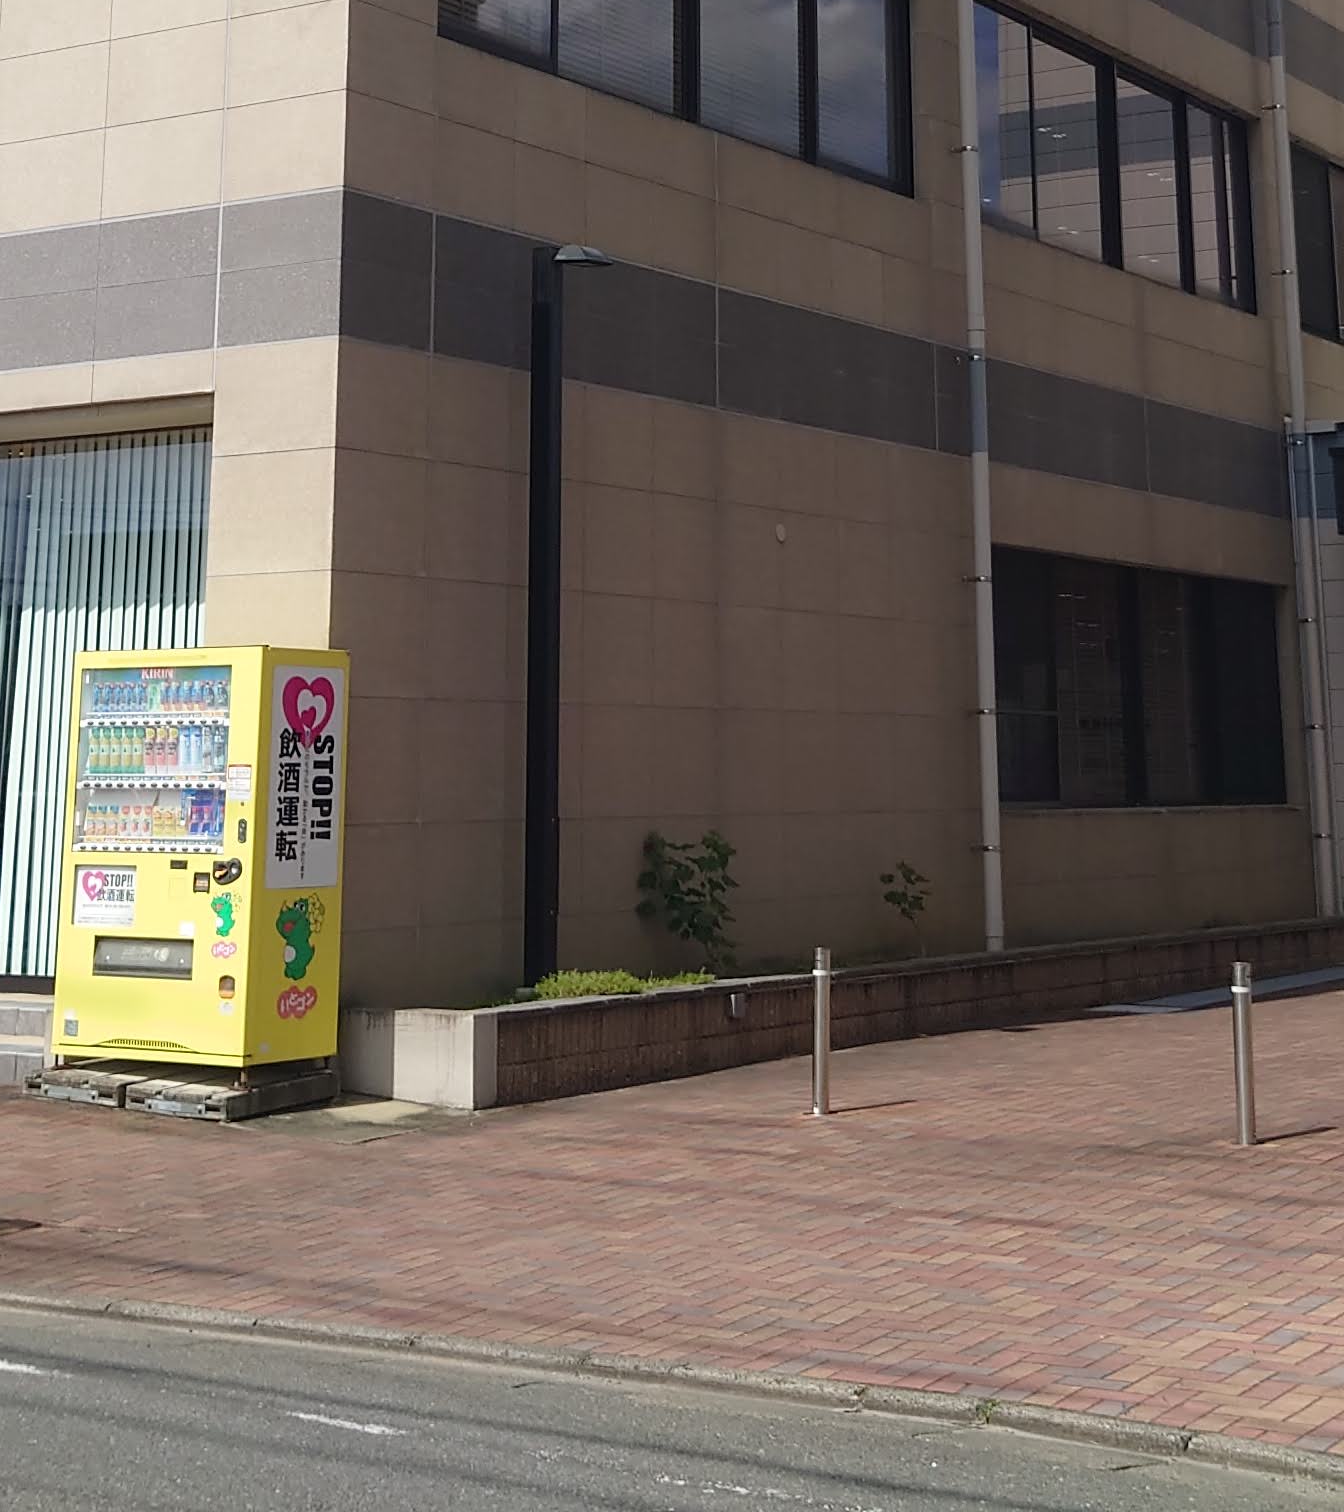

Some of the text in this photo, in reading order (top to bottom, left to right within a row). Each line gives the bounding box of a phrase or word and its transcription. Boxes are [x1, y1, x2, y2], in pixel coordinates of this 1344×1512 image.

[141, 666, 175, 680] KIRIN
[310, 733, 335, 841] STOP!!
[274, 727, 302, 863] 飲酒運転
[103, 873, 134, 888] STOP!!
[96, 888, 135, 903] 飲酒運転
